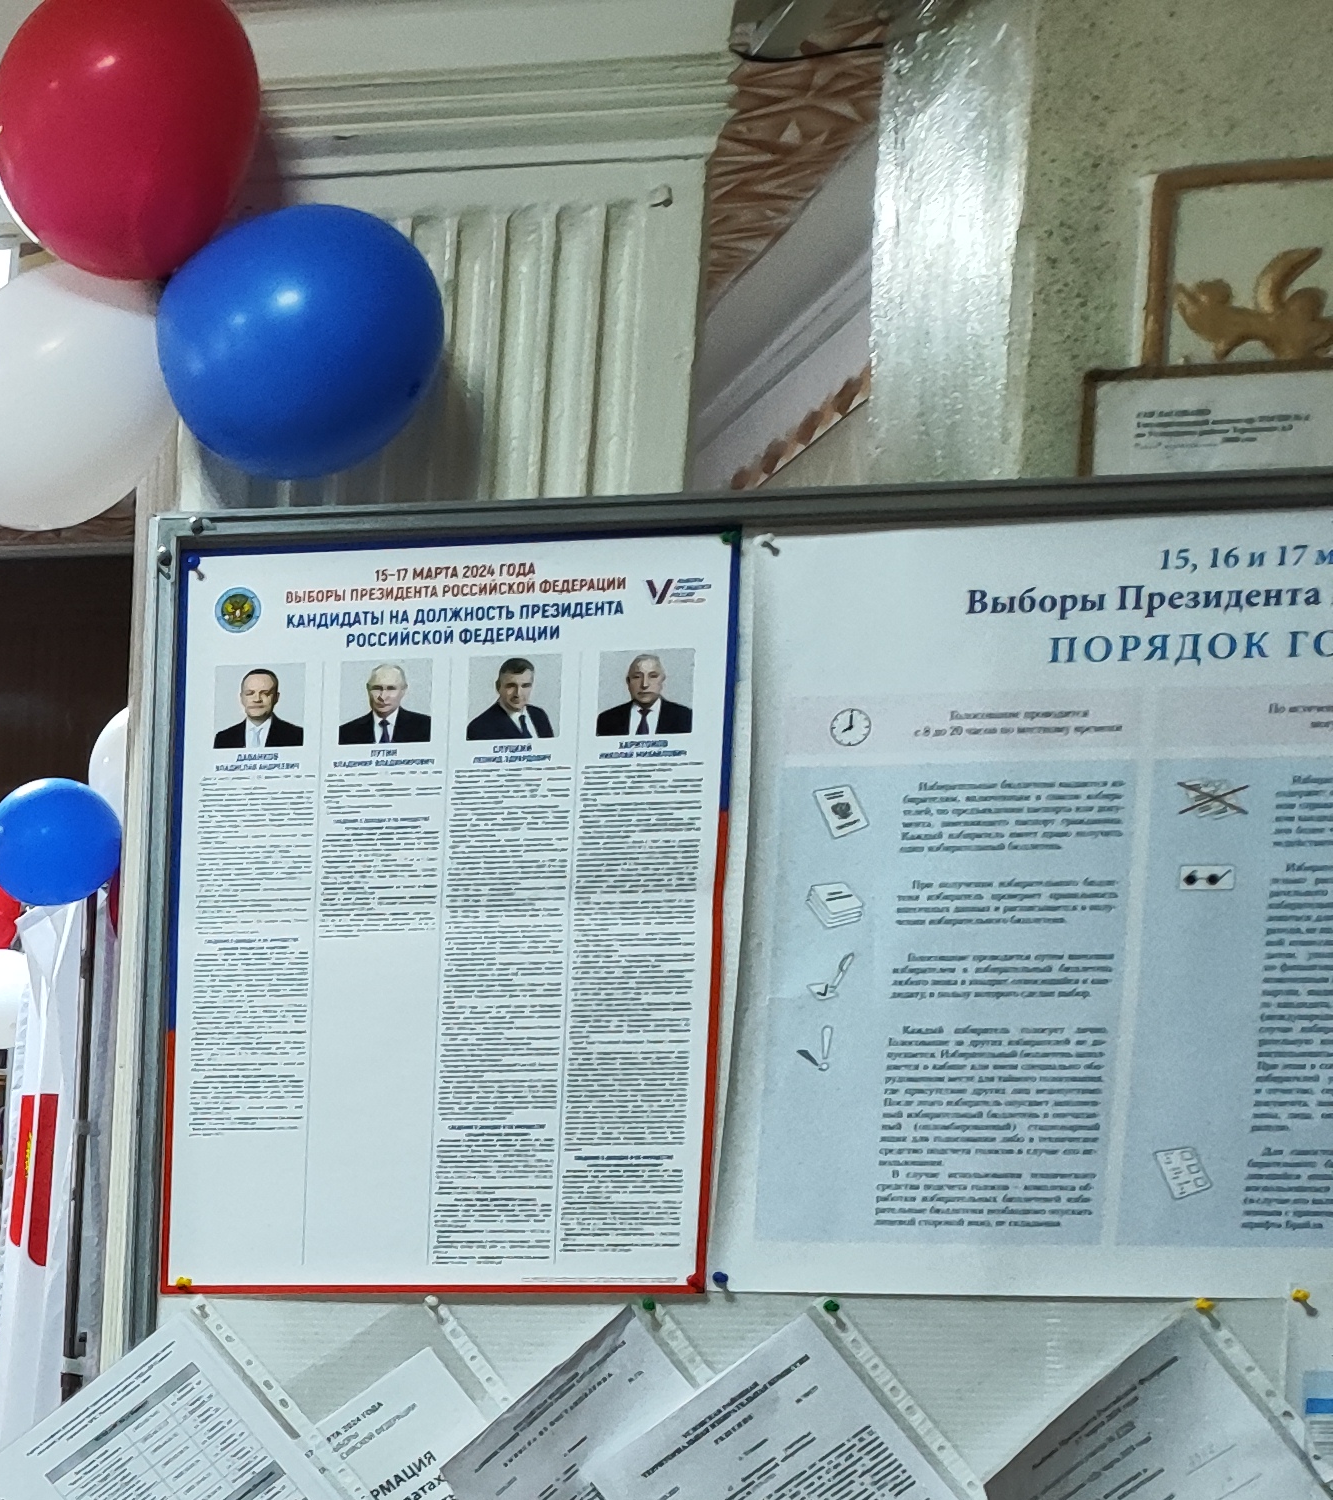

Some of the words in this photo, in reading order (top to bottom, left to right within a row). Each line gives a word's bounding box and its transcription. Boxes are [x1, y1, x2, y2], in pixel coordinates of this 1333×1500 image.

[412, 566, 458, 581] МАРТА
[462, 564, 495, 579] 2024
[499, 562, 536, 577] ГОДА
[1160, 548, 1198, 574] 15,
[1209, 546, 1240, 568] 16
[1247, 550, 1267, 568] и
[1277, 544, 1310, 566] 17
[286, 589, 346, 604] ВЫБОРЫ
[351, 584, 438, 601] ПРЕЗИДЕНТА
[442, 577, 536, 598] РОССИЙСКОЙ
[539, 577, 627, 595] ФЕДЕРАЦИИ
[965, 586, 1106, 620] Выборы
[1115, 584, 1322, 619] Президента
[286, 609, 384, 630] КАНДИДАТЫ
[390, 609, 409, 625] НА
[413, 605, 515, 627] ДОЛЖНОСТЬ
[519, 600, 624, 619] ПРЕЗИДЕНТА
[346, 625, 454, 648] РОССИЙСКОЙ
[458, 625, 561, 646] ФЕДЕРАЦИИ
[1048, 631, 1270, 667] ПОРЯДОК
